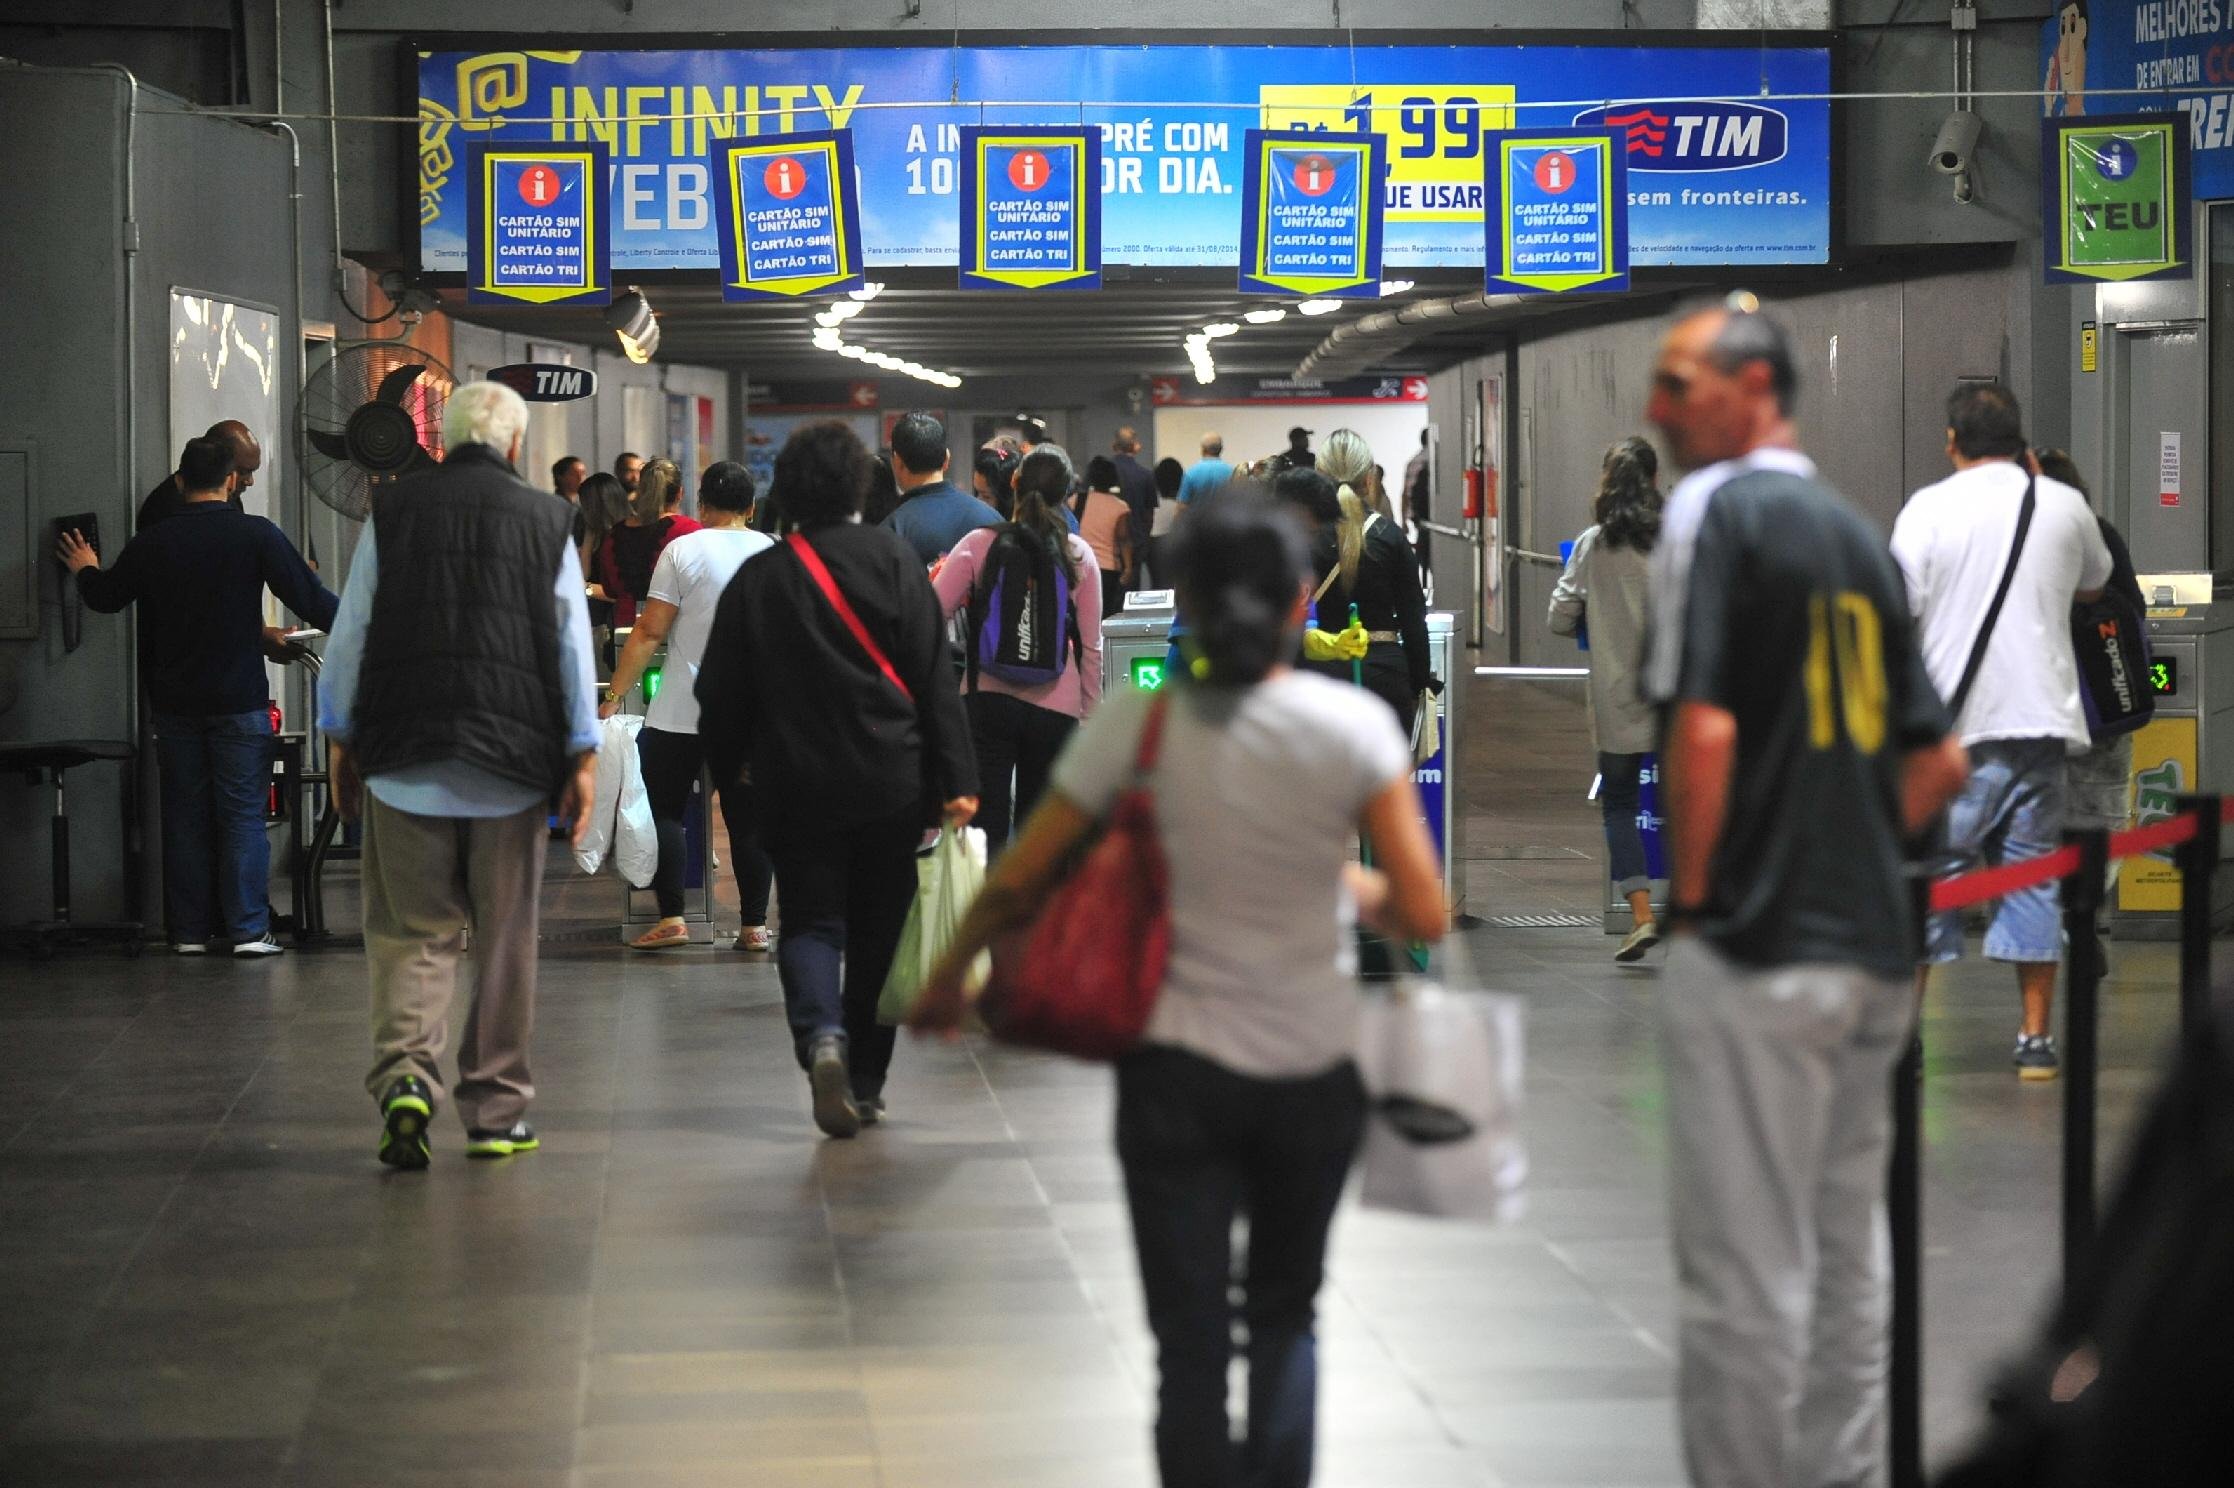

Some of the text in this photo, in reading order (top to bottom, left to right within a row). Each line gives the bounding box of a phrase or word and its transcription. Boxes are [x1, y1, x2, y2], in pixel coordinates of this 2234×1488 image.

[2135, 0, 2221, 44] MELHORES
[2136, 62, 2148, 90] DE
[2149, 56, 2184, 89] ENTRAR
[2186, 54, 2200, 82] EM
[552, 84, 864, 157] INFINITY
[905, 123, 928, 153] A
[1163, 122, 1228, 152] COM
[1673, 116, 1763, 157] TIM
[1158, 157, 1233, 195] DIA.
[610, 164, 709, 231] EB
[1423, 186, 1482, 208] USAR
[1627, 188, 1808, 206] sem fronteiras.
[989, 200, 1070, 212] CARTÃO SIM
[1273, 204, 1354, 217] CARTÃO SIM
[1514, 202, 1597, 215] CARTÃO SIM
[499, 215, 580, 227] CARTÃO SIM
[748, 206, 829, 222] CARTÃO SIM
[997, 211, 1062, 223] UNITÁRIO
[1281, 215, 1347, 228] UNITÁRIO
[1523, 213, 1589, 226] UNITÁRIO
[2077, 202, 2158, 231] TEU
[507, 226, 572, 238] UNITÁRIO
[757, 217, 822, 232] UNITÁRIO
[990, 228, 1069, 241] CARTÃO SIM
[1273, 233, 1354, 246] CARTÃO SIM
[1516, 230, 1597, 244] CARTÃO SIM
[500, 244, 580, 256] CARTÃO SIM
[751, 235, 832, 251] CARTÃO SIM
[990, 248, 1068, 260] CARTÃO TRI
[1274, 252, 1352, 265] CARTÃO TRI
[1516, 250, 1596, 264] CARTÃO TRI
[500, 263, 578, 275] CARTÃO TRI
[754, 254, 832, 270] CARTÃO TRI
[536, 371, 582, 395] TIM
[1639, 763, 1659, 785] si
